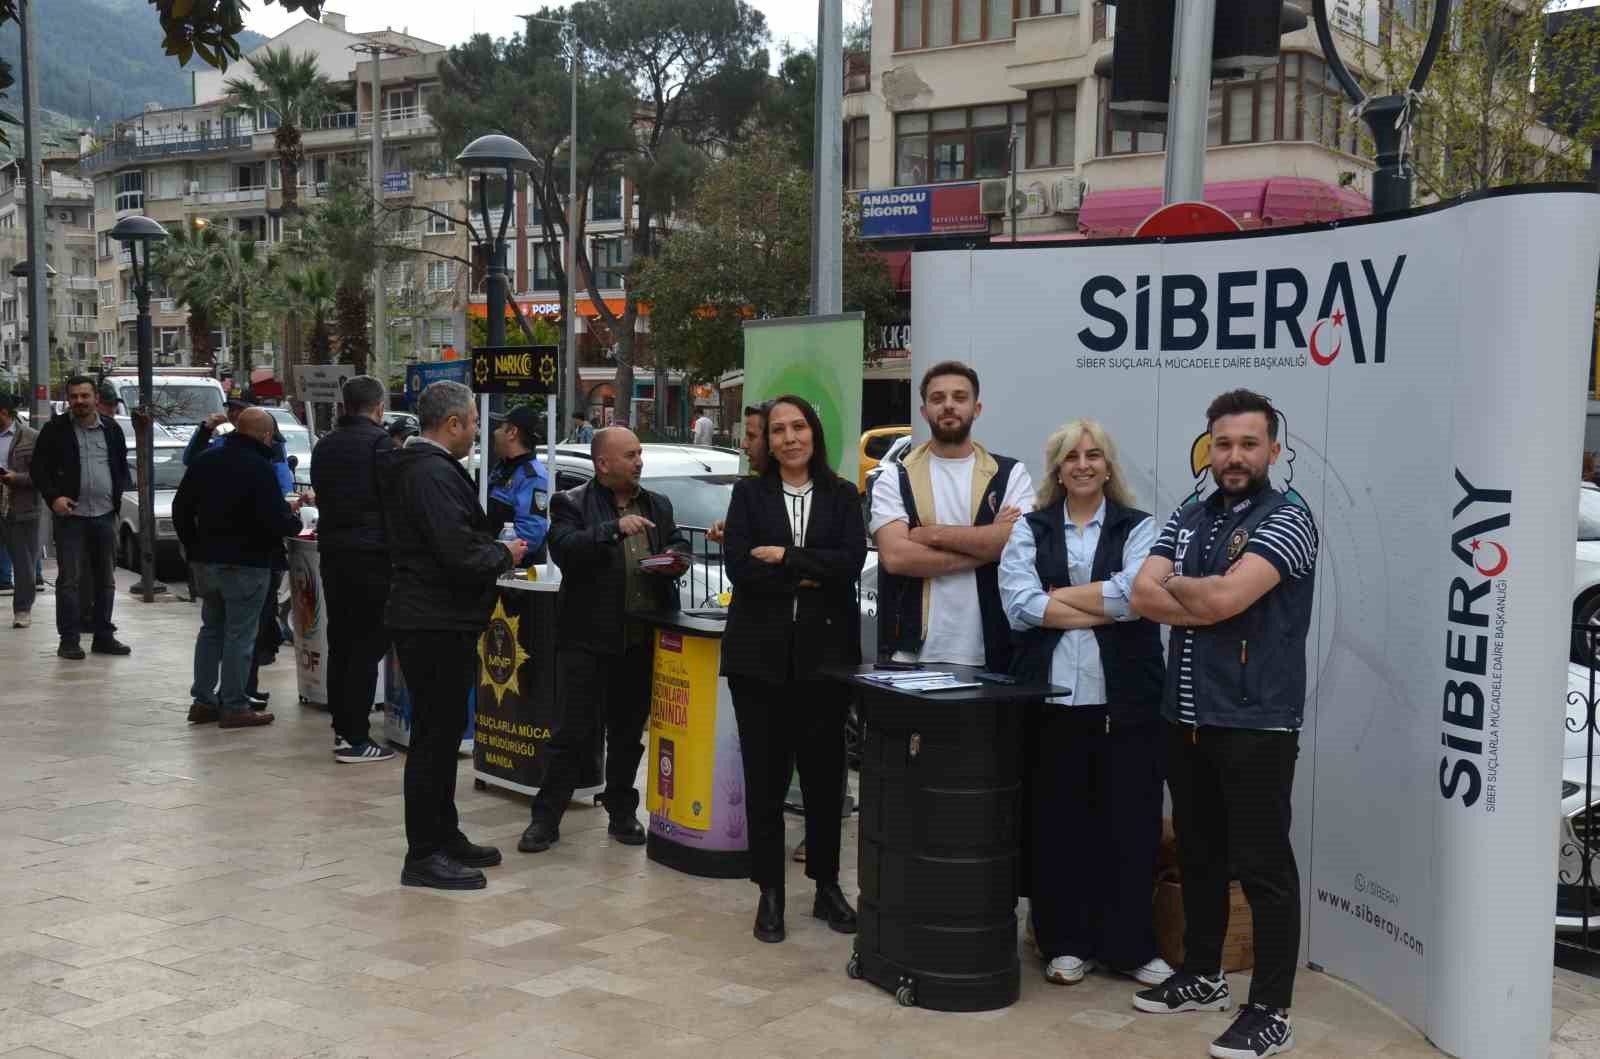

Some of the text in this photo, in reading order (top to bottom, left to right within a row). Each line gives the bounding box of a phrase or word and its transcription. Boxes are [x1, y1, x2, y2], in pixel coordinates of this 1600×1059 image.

[862, 192, 926, 206] ANADOLU
[863, 204, 918, 218] SİGORTA
[532, 303, 570, 315] POPE
[1076, 354, 1308, 370] SİBER SUÇLARLA MÜCADELE DAİRE BAŞKANLIĞI
[1495, 579, 1508, 639] BAŞKANLIĞI
[1489, 672, 1502, 728] MÜCADELE
[518, 723, 552, 739] MÜCA
[1487, 730, 1499, 784] SUÇLARLA
[1317, 888, 1424, 957] www.siberay.com
